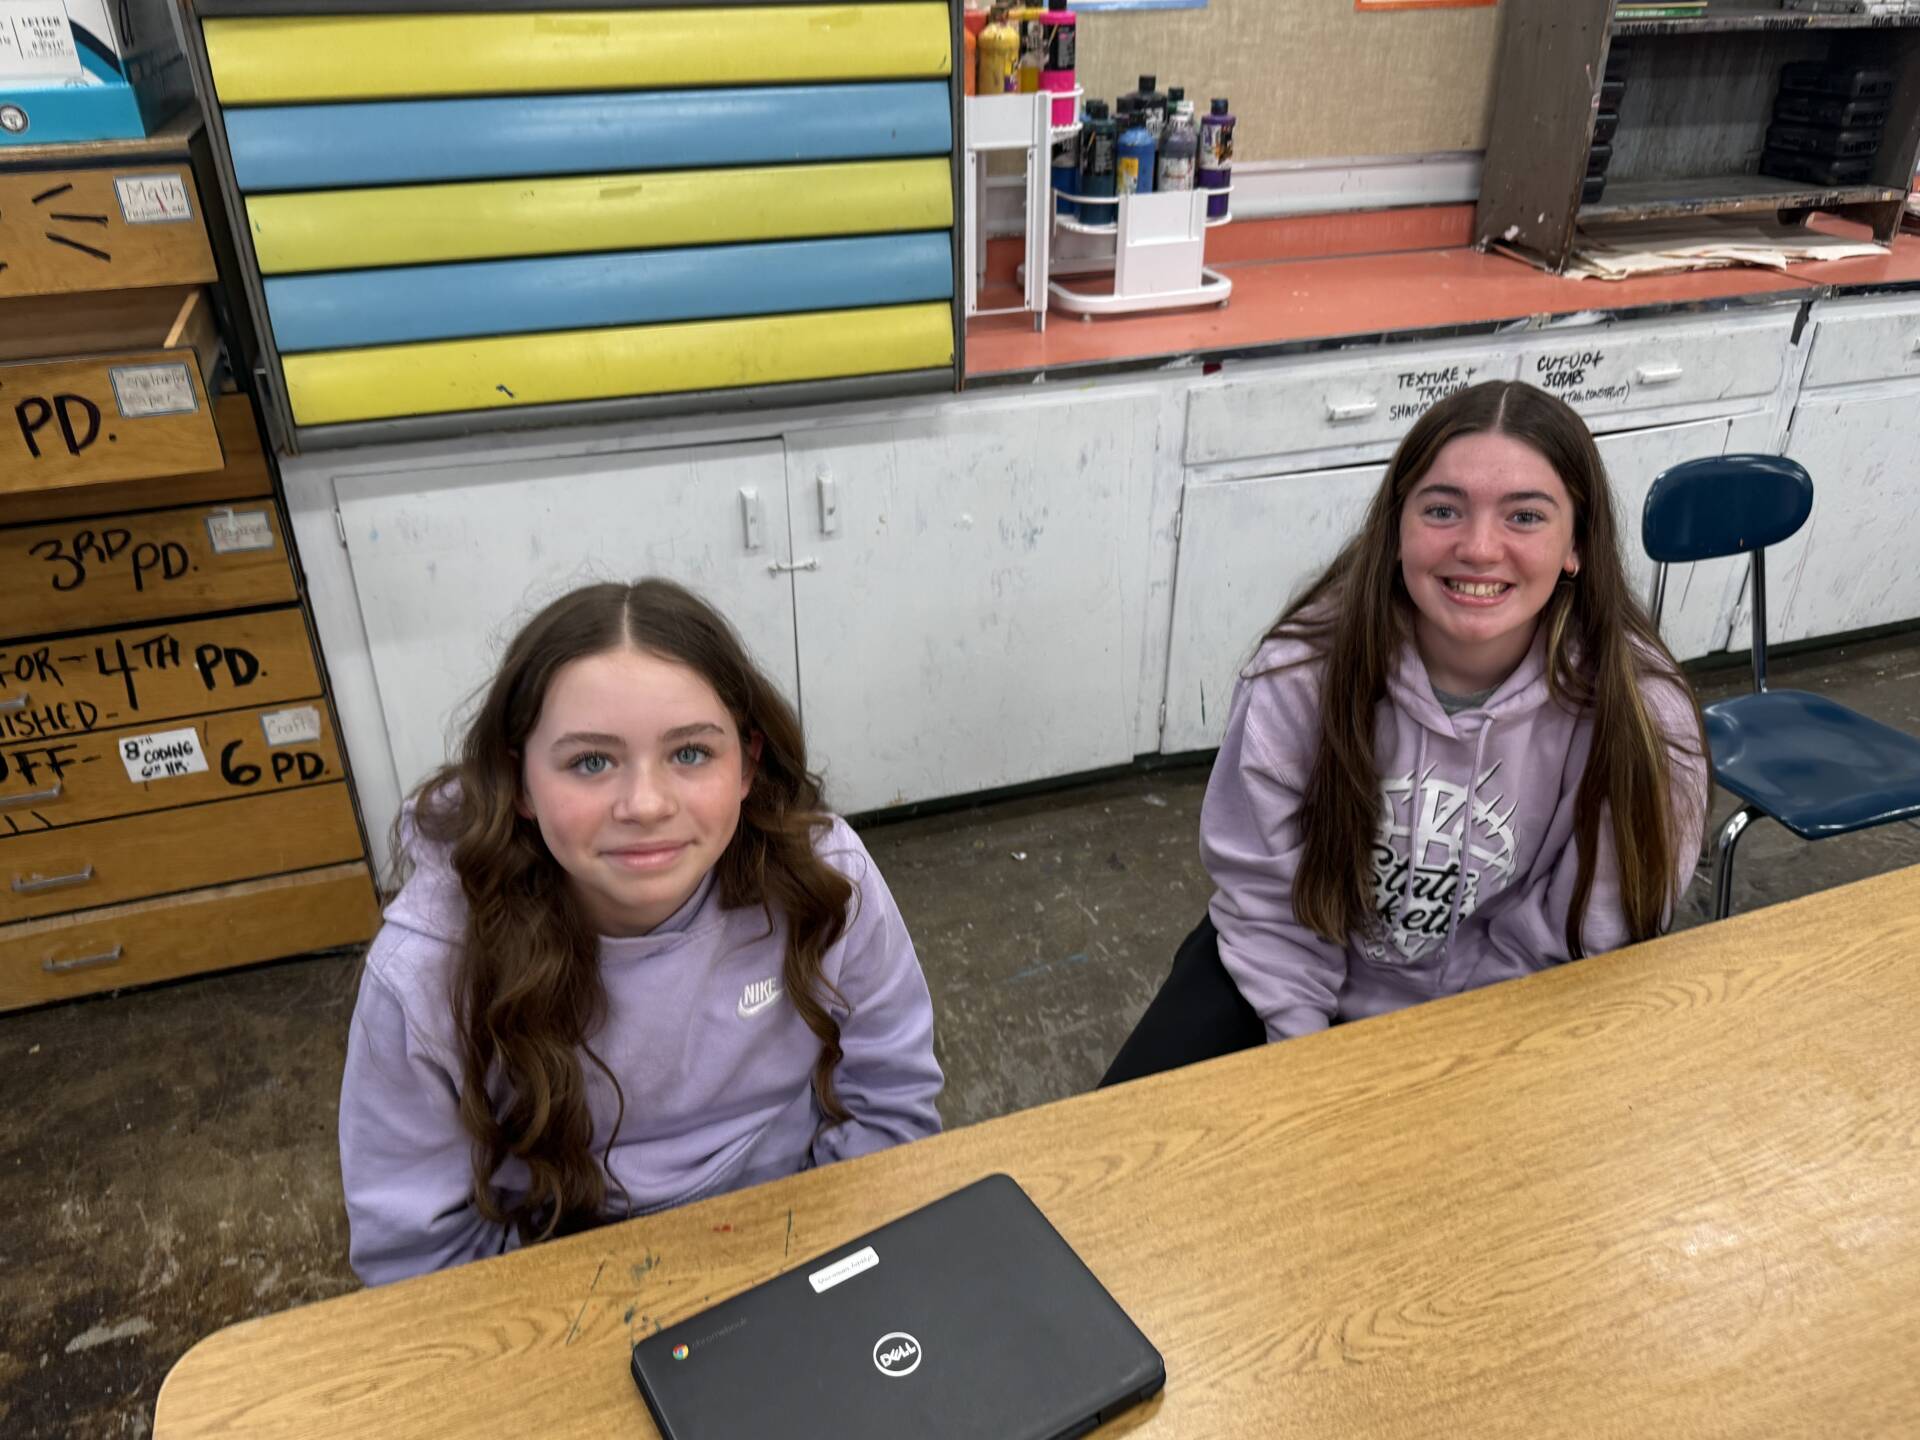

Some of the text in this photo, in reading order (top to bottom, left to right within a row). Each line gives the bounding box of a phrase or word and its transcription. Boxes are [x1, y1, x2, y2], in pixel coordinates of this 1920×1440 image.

[1397, 366, 1459, 391] TEXTURE
[14, 392, 117, 459] PD.
[28, 528, 199, 592] 3RD PD.
[95, 633, 180, 711] 4TH
[194, 644, 268, 691] PD.
[144, 740, 194, 764] CODING
[220, 740, 262, 785] 6
[271, 752, 332, 783] PD.
[744, 977, 777, 1006] NIKE
[880, 1341, 917, 1368] DELL
